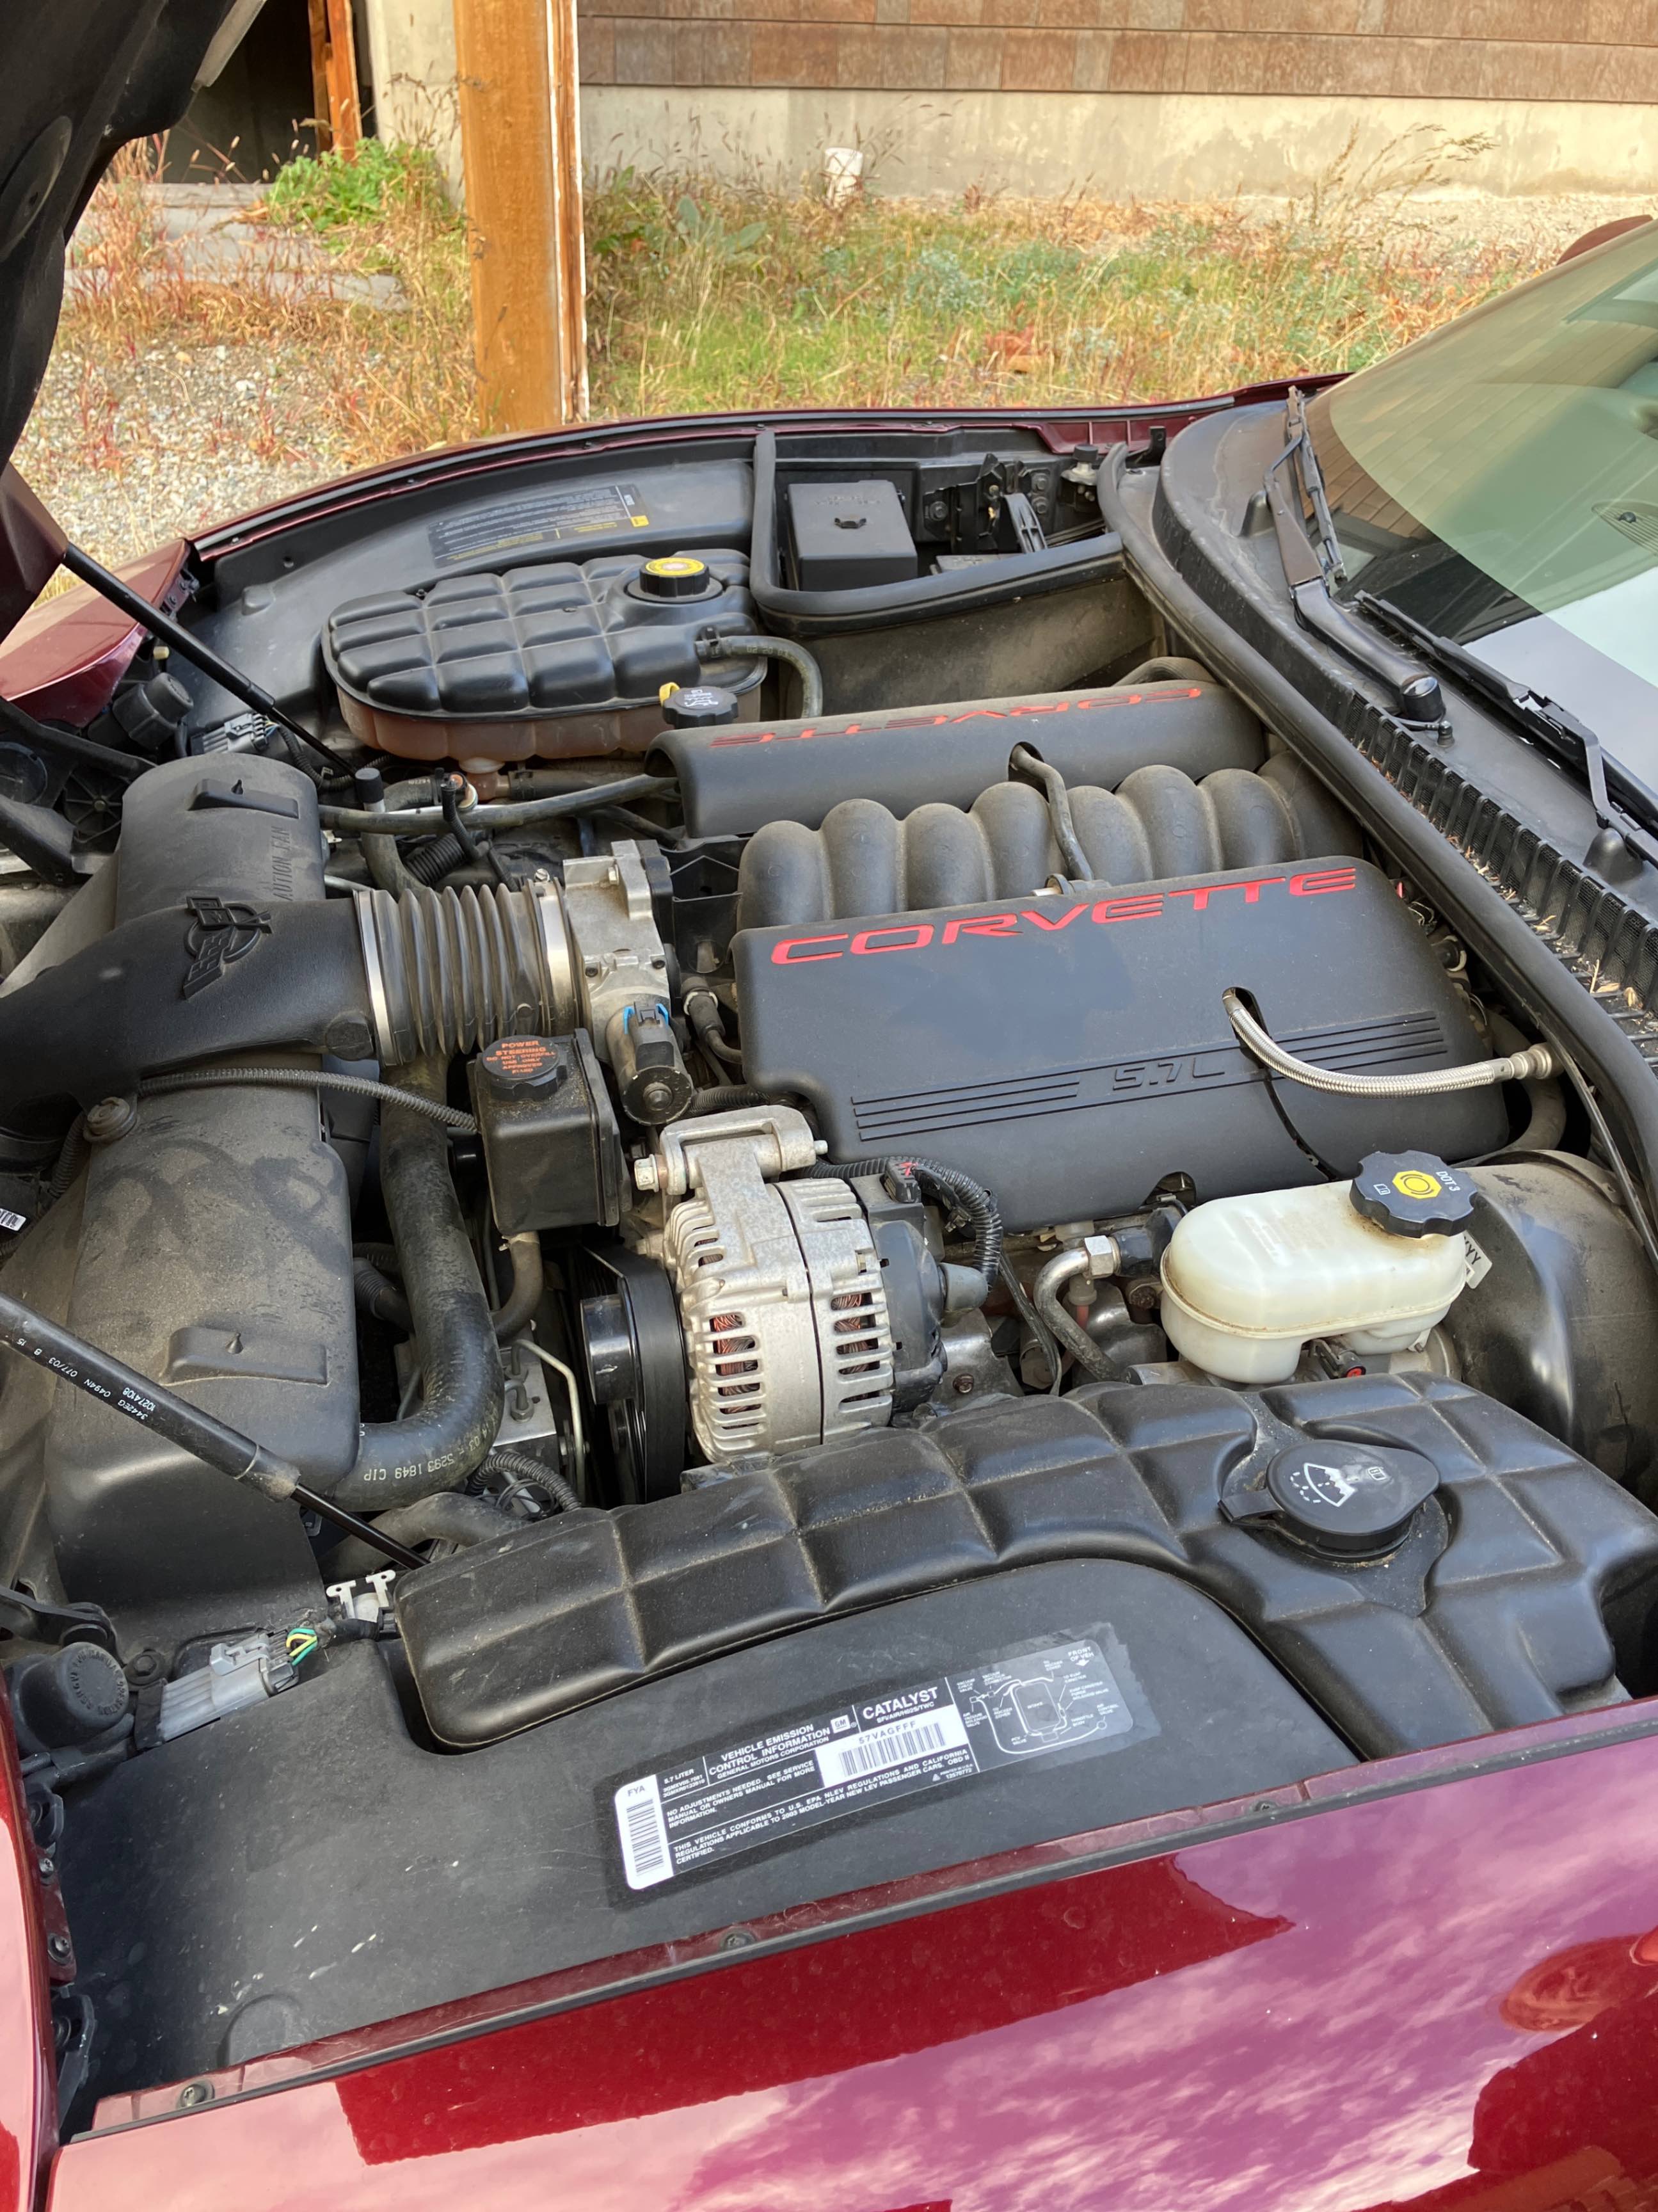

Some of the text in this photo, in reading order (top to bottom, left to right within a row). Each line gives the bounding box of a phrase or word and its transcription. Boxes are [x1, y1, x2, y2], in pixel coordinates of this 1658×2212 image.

[710, 688, 1202, 748] CORVETTE
[271, 855, 292, 901] AUTION
[770, 867, 1357, 966] CORVETTE
[495, 1046, 546, 1056] STEERING
[1435, 1170, 1456, 1185] DOT
[15, 1336, 28, 1347] 15
[47, 1354, 79, 1379] 077/03
[82, 1376, 112, 1399] 0494N
[122, 1385, 157, 1412] 10274108
[116, 1397, 149, 1422] 3442EG
[363, 1468, 387, 1480] CIP
[393, 1463, 422, 1479] 1849
[426, 1452, 454, 1472] 5293
[1068, 1646, 1090, 1656] FRONT
[863, 1687, 938, 1719] CATALYST
[834, 1719, 846, 1727] GM
[709, 1727, 830, 1775] CONTROL INFORMATION
[721, 1724, 813, 1761] VEHICLE EMISSION
[717, 1736, 829, 1778] GENERAL MOTORS CORPORATION
[674, 1768, 694, 1779] LITER
[680, 1790, 729, 1811] ADJUSTMENTS
[767, 1771, 781, 1780] SEE
[783, 1760, 813, 1774] SERVICE
[627, 1785, 645, 1797] FYA
[667, 1765, 815, 1822] MANUAL OR OWNERS MANUAL FOR MORE
[674, 1841, 691, 1852] THIS
[694, 1829, 726, 1843] VEHICLE
[729, 1813, 771, 1831] CONFORMS
[788, 1802, 802, 1810] U.S.
[824, 1787, 844, 1798] NLEV
[847, 1770, 899, 1789] REGULATIONS
[902, 1763, 919, 1772] AND
[922, 1749, 967, 1766] CALIFORNIA
[669, 1807, 716, 1827] INFORMATION.
[675, 1837, 724, 1857] REGULATIONS
[726, 1820, 769, 1839] APPLICABLE
[781, 1810, 797, 1820] 2003
[799, 1794, 844, 1813] MODEL-YEAR
[846, 1788, 863, 1797] NEW
[863, 1783, 877, 1791] LEV
[880, 1769, 921, 1785] PASSENGER
[922, 1761, 944, 1772] CARS.
[947, 1756, 964, 1765] OBD
[676, 1847, 714, 1864] CERTIFIED.
